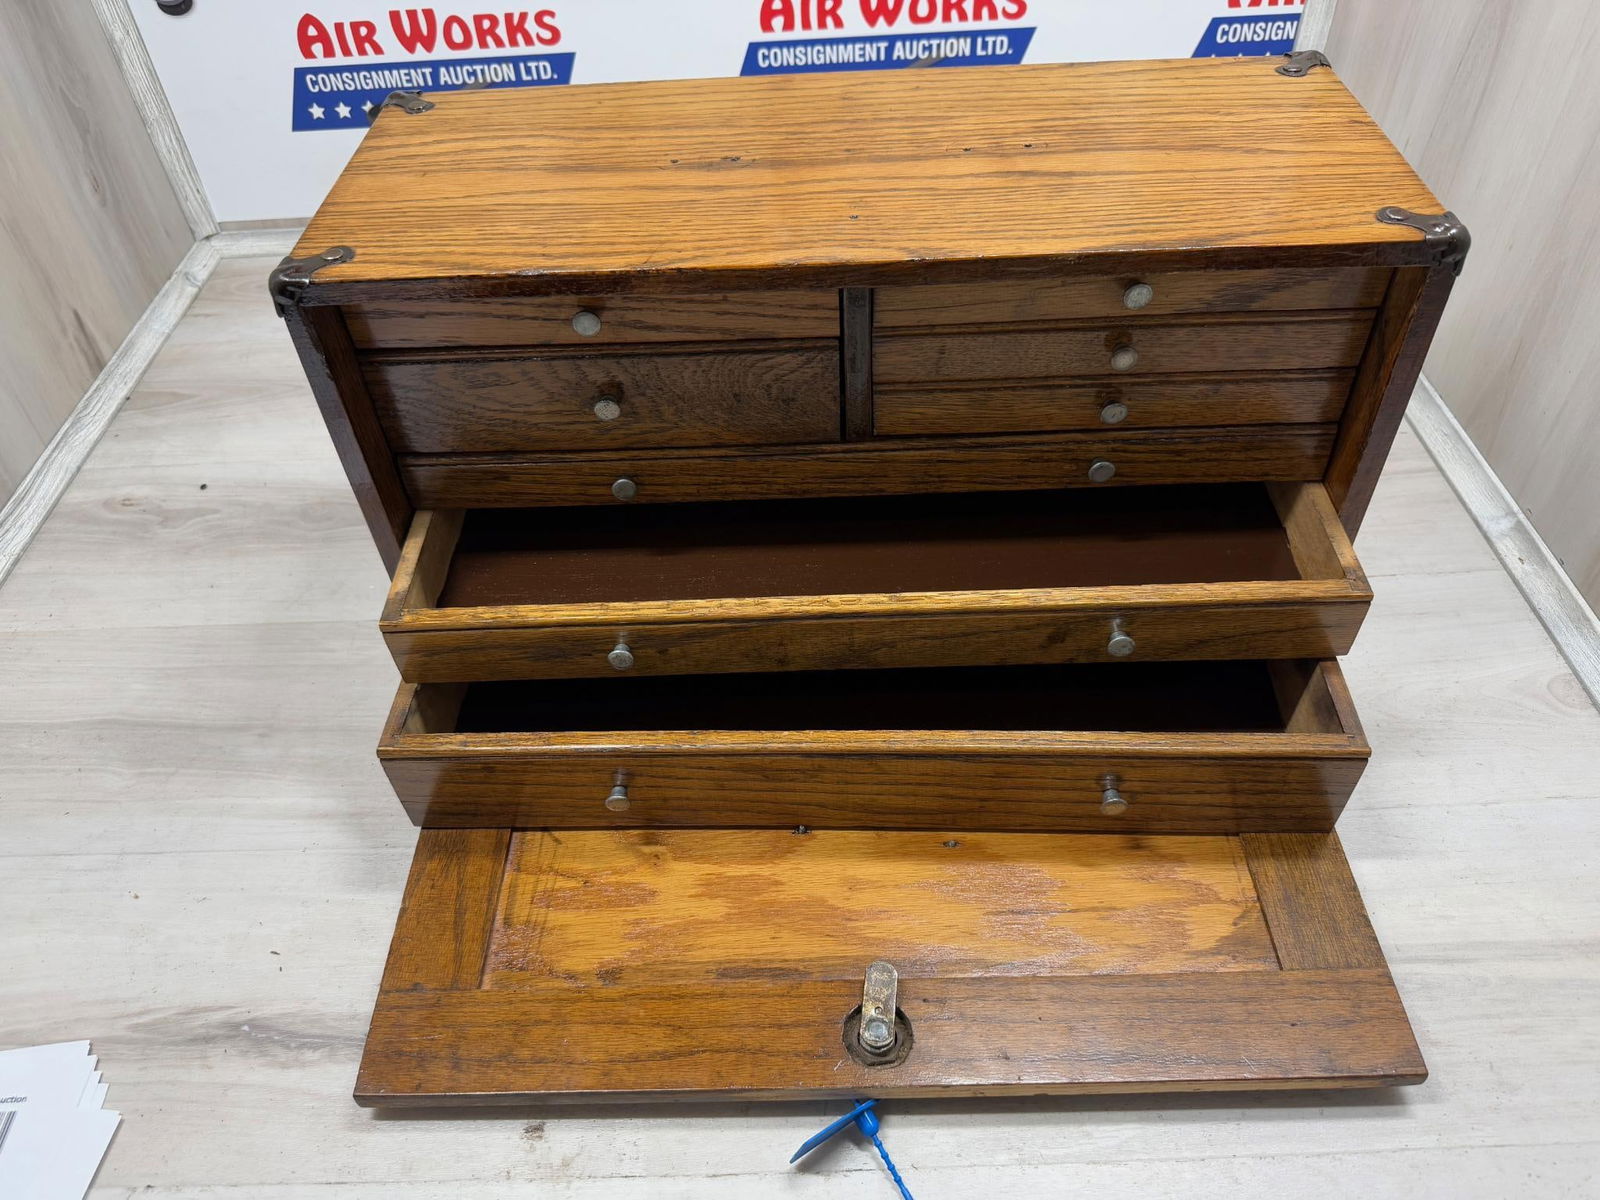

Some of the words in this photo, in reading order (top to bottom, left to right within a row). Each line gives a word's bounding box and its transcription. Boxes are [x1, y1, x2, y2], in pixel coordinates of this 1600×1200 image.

[297, 13, 384, 60] AIR
[389, 8, 562, 55] WORKS
[1216, 20, 1298, 44] CONSIGN
[757, 42, 888, 68] CONSIGNMENT
[893, 37, 970, 61] AUCTION
[976, 36, 1013, 56] LTD.
[306, 68, 433, 93] CONSIGNMENT
[439, 63, 516, 85] AUCTION
[519, 61, 558, 82] LTD.
